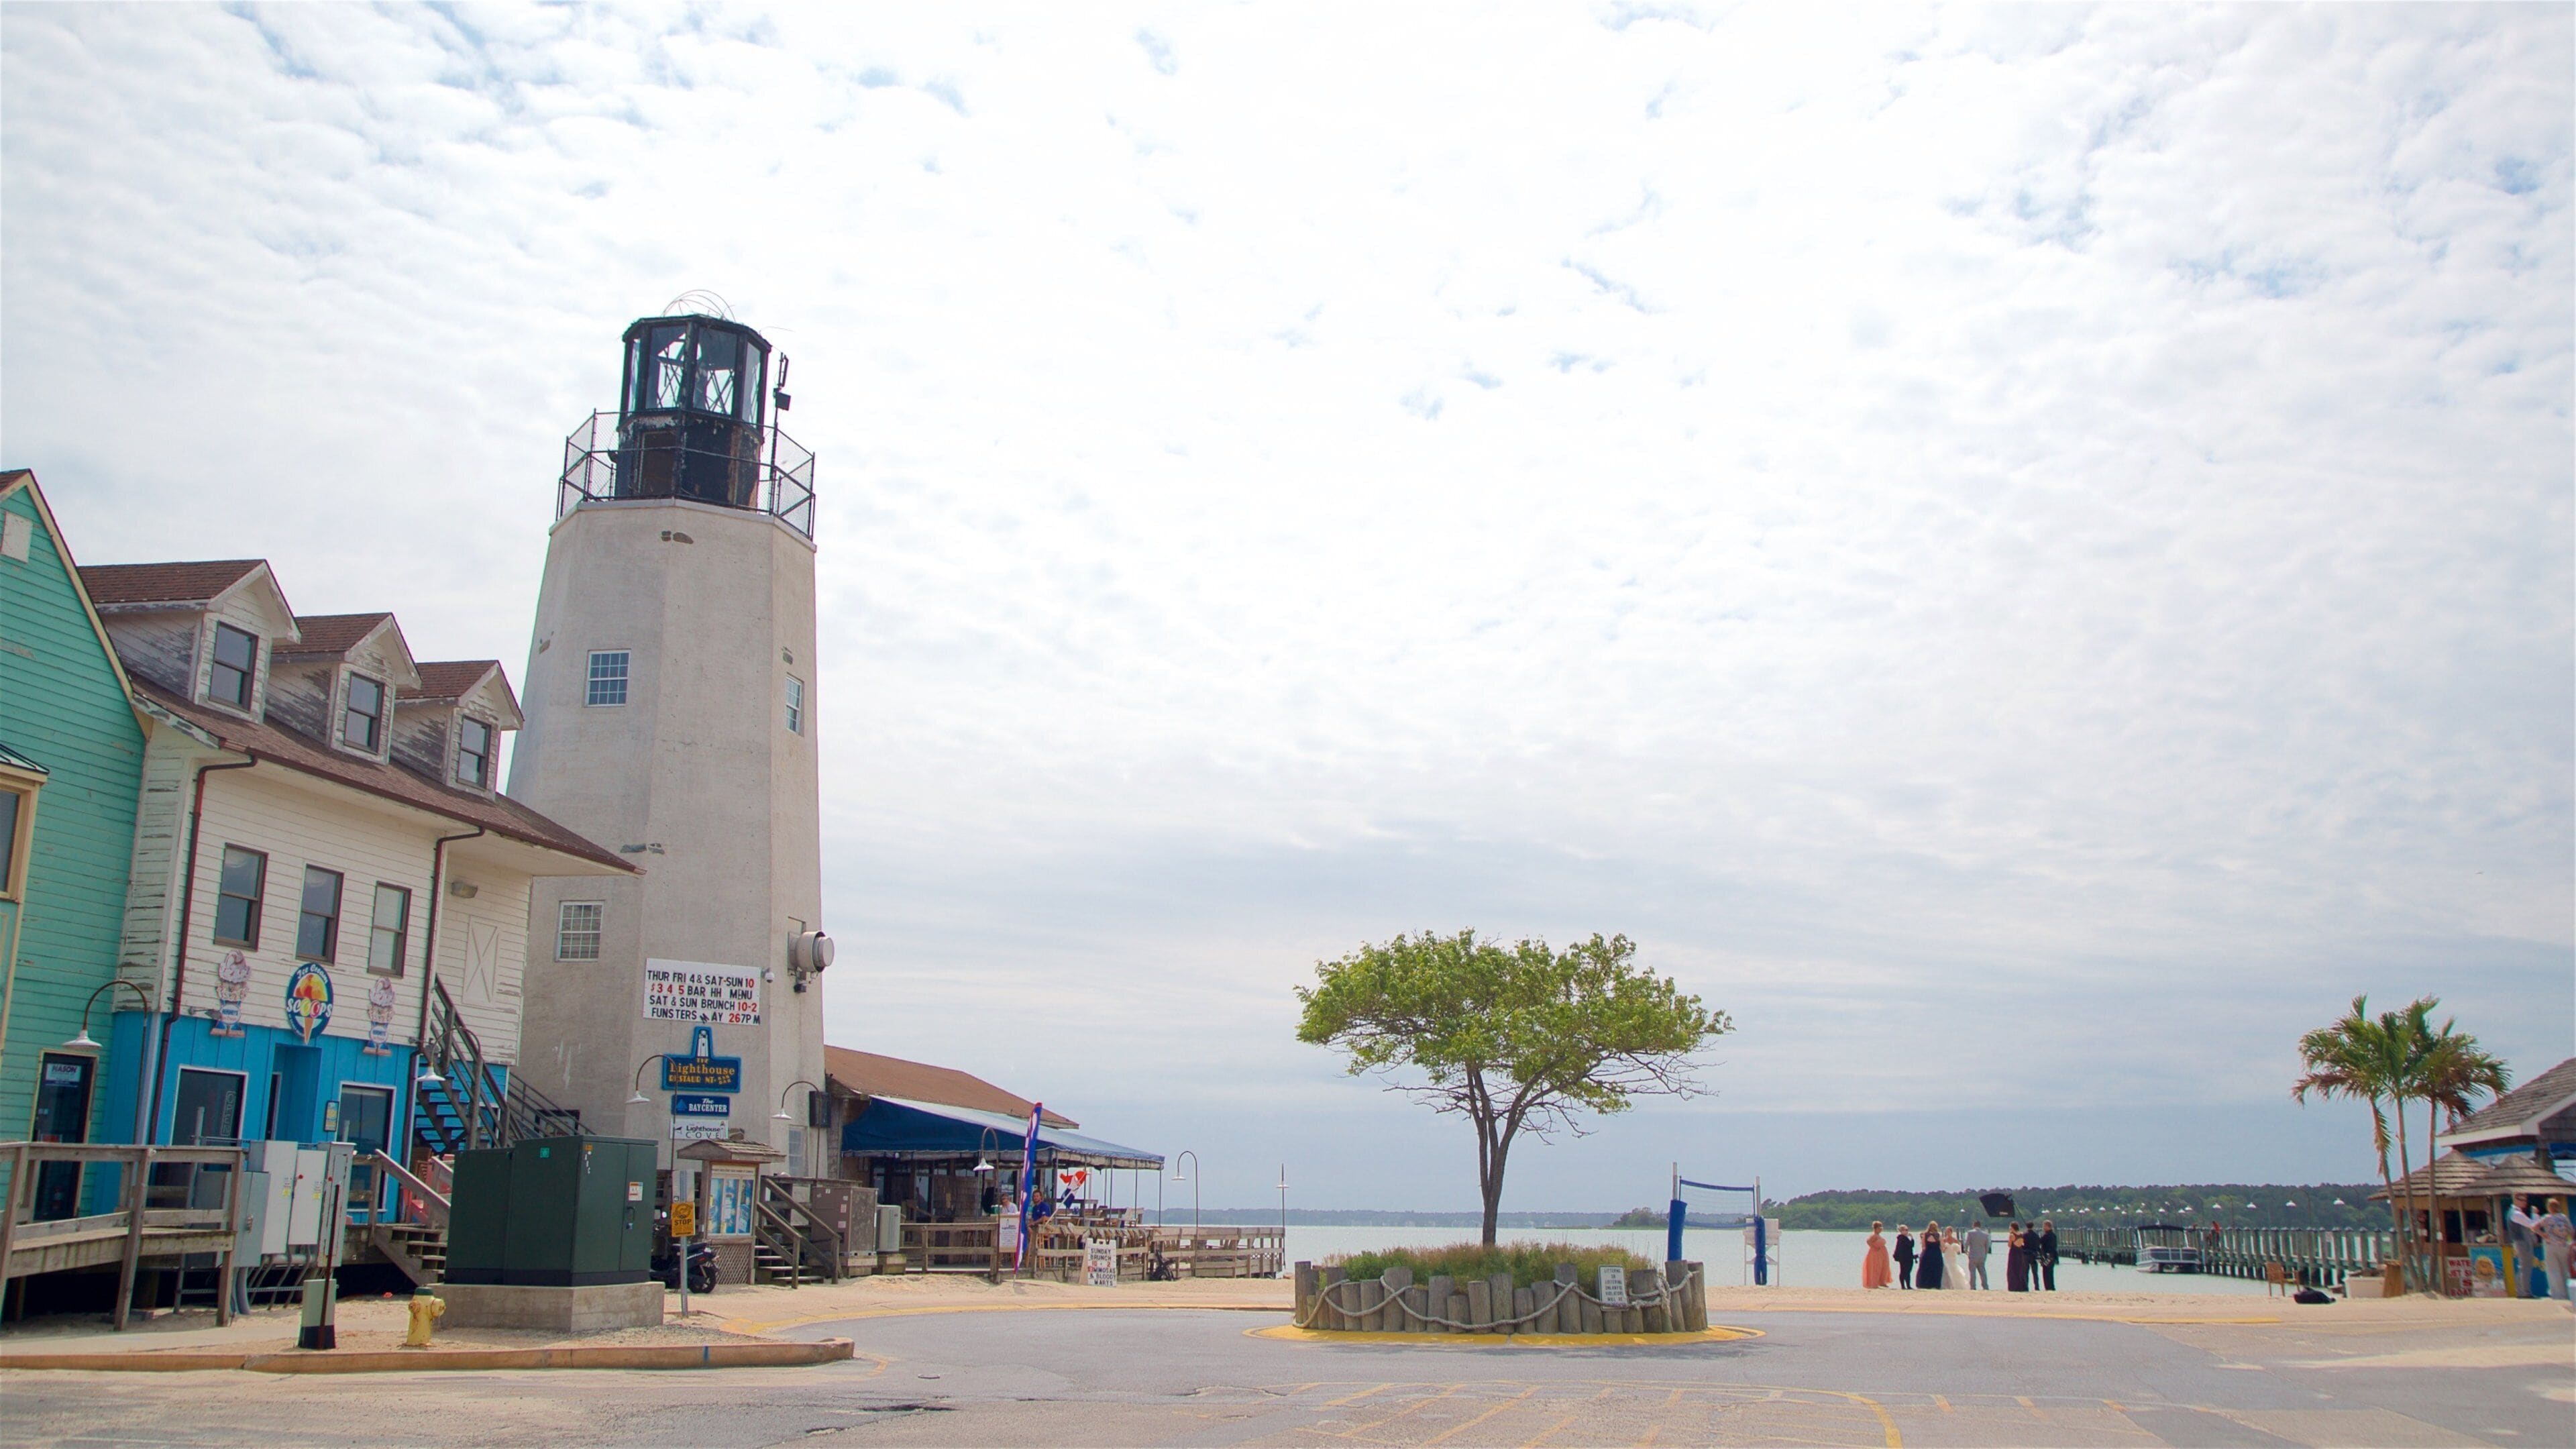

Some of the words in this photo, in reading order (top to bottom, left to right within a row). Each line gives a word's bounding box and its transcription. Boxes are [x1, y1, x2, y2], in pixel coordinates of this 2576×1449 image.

[297, 967, 309, 979] Ice
[310, 964, 328, 984] Cream
[647, 970, 669, 981] THUR
[672, 972, 686, 983] FRI
[690, 974, 695, 983] 4
[696, 975, 702, 983] &
[745, 978, 755, 988] 10
[667, 984, 673, 994] 4
[678, 985, 684, 995] 5
[687, 985, 706, 997] BAR
[710, 987, 722, 998] HH
[730, 989, 753, 1000] MENU
[286, 998, 333, 1018] SCOOPS
[649, 995, 668, 1006] SAT
[671, 996, 676, 1006] &
[680, 997, 698, 1008] SUN
[701, 999, 735, 1011] BRUNCH
[738, 1002, 757, 1012] 10-2
[651, 1007, 697, 1020] FUNSTERS
[670, 1063, 735, 1075] Lighthouse
[688, 1104, 728, 1113] BAYCENTER
